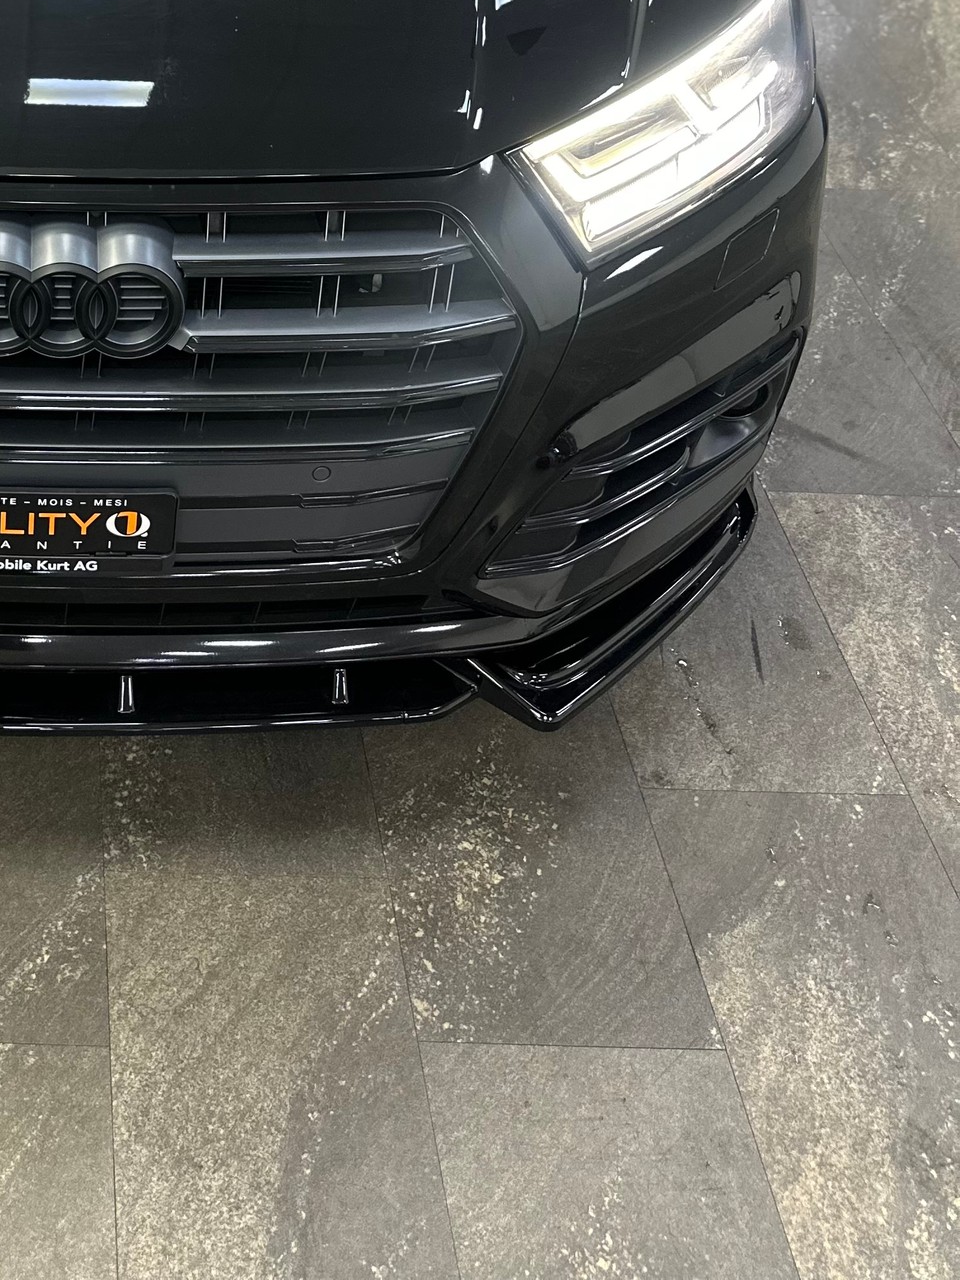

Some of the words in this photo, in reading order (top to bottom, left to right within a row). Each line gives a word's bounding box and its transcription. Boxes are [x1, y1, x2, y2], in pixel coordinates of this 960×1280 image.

[37, 498, 73, 507] MOIS
[93, 499, 128, 507] MESI
[36, 560, 71, 571] Kurt
[73, 560, 99, 572] AG
